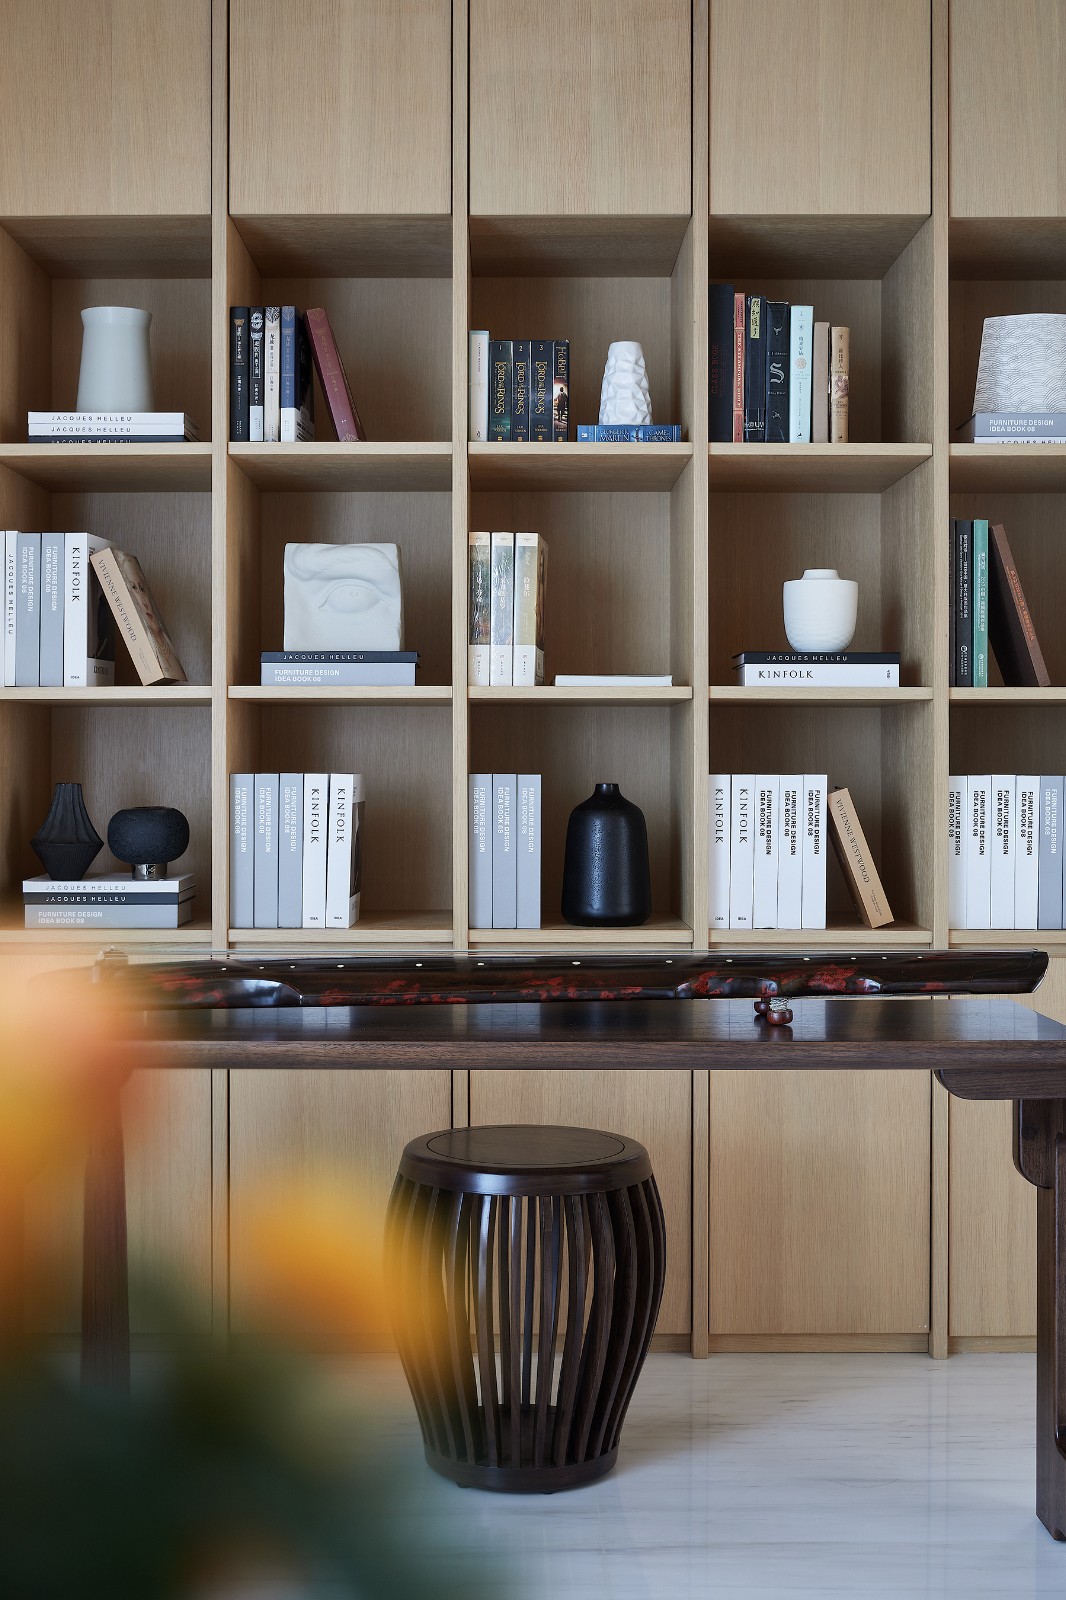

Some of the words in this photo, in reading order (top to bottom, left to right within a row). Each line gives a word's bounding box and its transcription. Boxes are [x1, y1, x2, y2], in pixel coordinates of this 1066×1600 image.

[495, 388, 506, 414] RINGS
[515, 388, 525, 415] RINGS
[535, 388, 546, 414] RINGS
[71, 547, 80, 602] KINFOLK
[98, 559, 117, 596] VIVIENNE
[114, 596, 137, 642] WESTWOOD
[758, 670, 814, 679] KINFOLK
[311, 788, 320, 843] KINFOLK
[336, 788, 345, 843] KINFOLK
[715, 788, 724, 843] KINFOLK
[739, 788, 748, 843] KINFOLK
[836, 798, 853, 836] VIVIENNE
[850, 836, 870, 883] WESTWOOD
